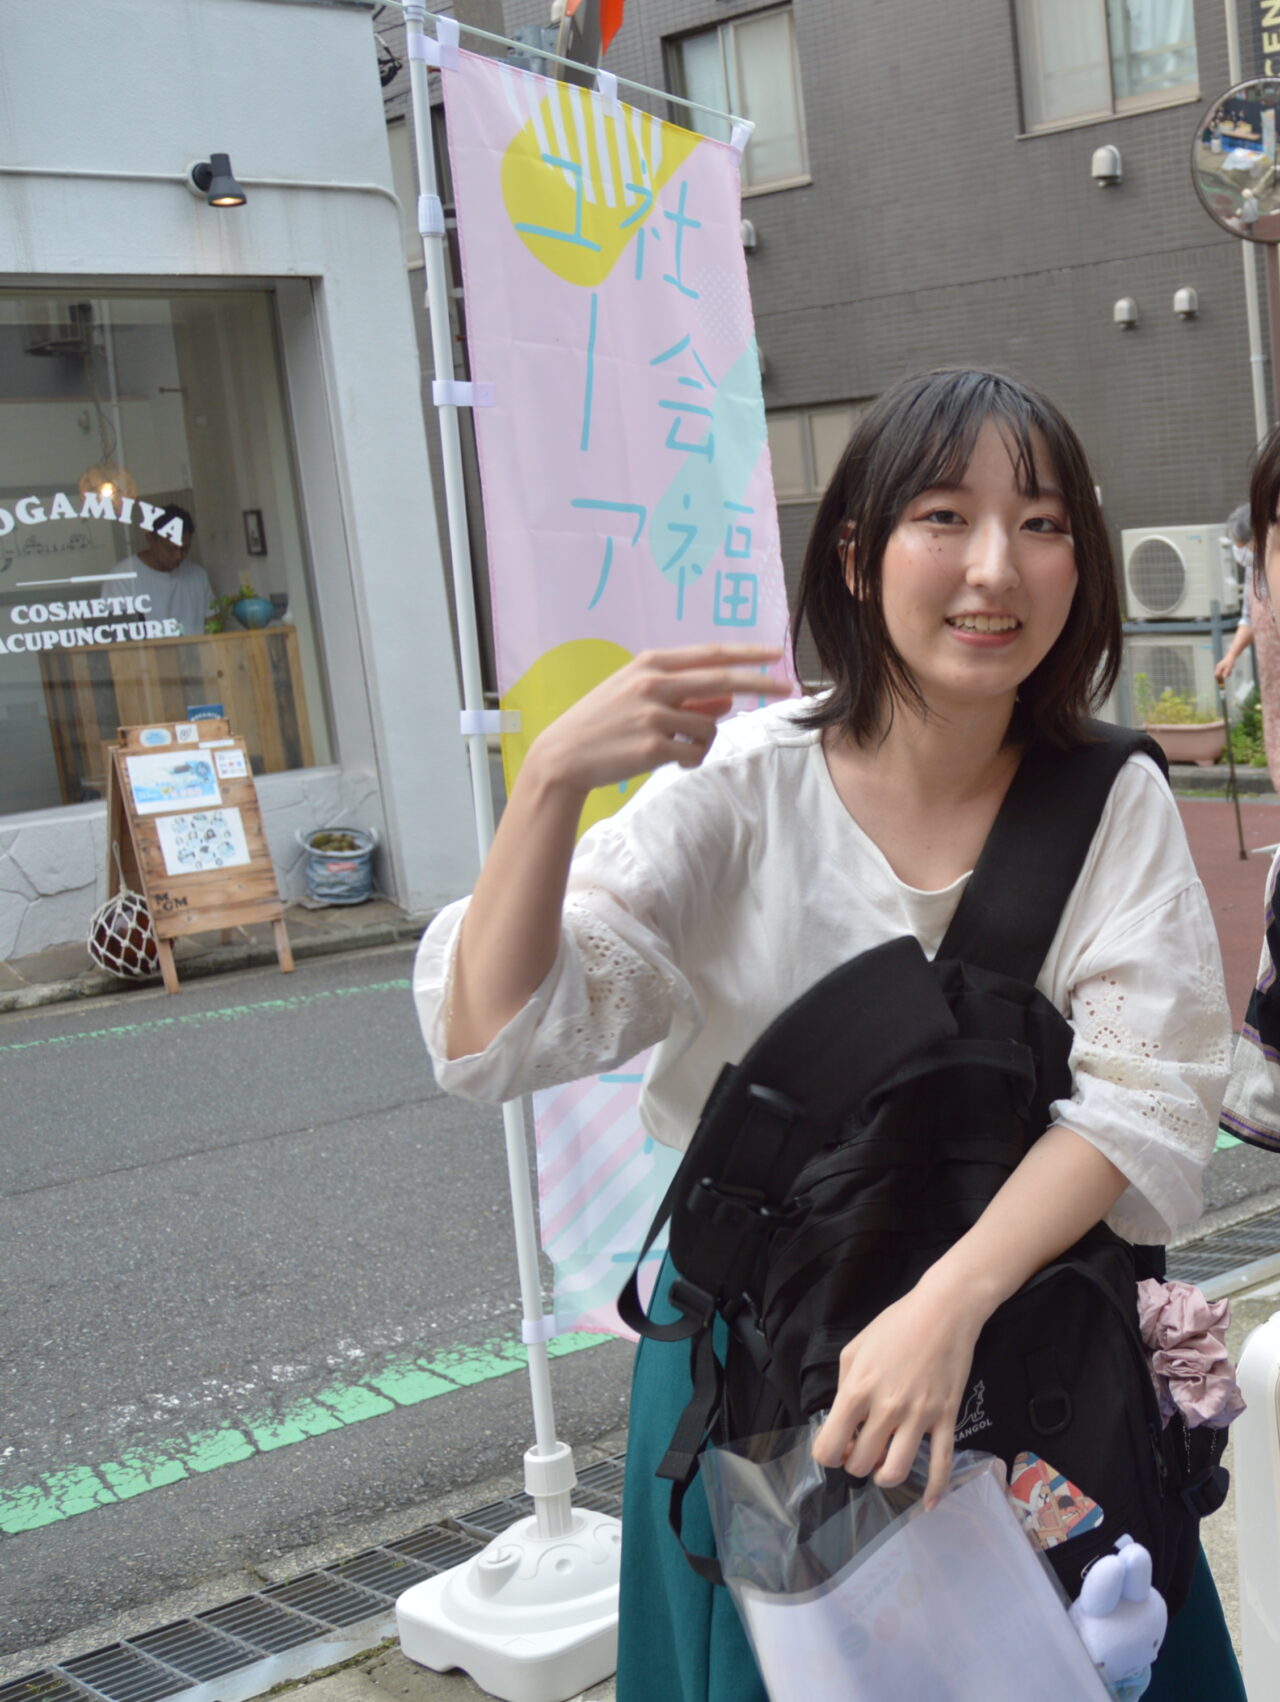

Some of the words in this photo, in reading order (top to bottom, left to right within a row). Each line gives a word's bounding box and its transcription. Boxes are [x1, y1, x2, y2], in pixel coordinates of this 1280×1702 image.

[619, 158, 772, 708] 社会福
[10, 595, 152, 625] COSMETIC
